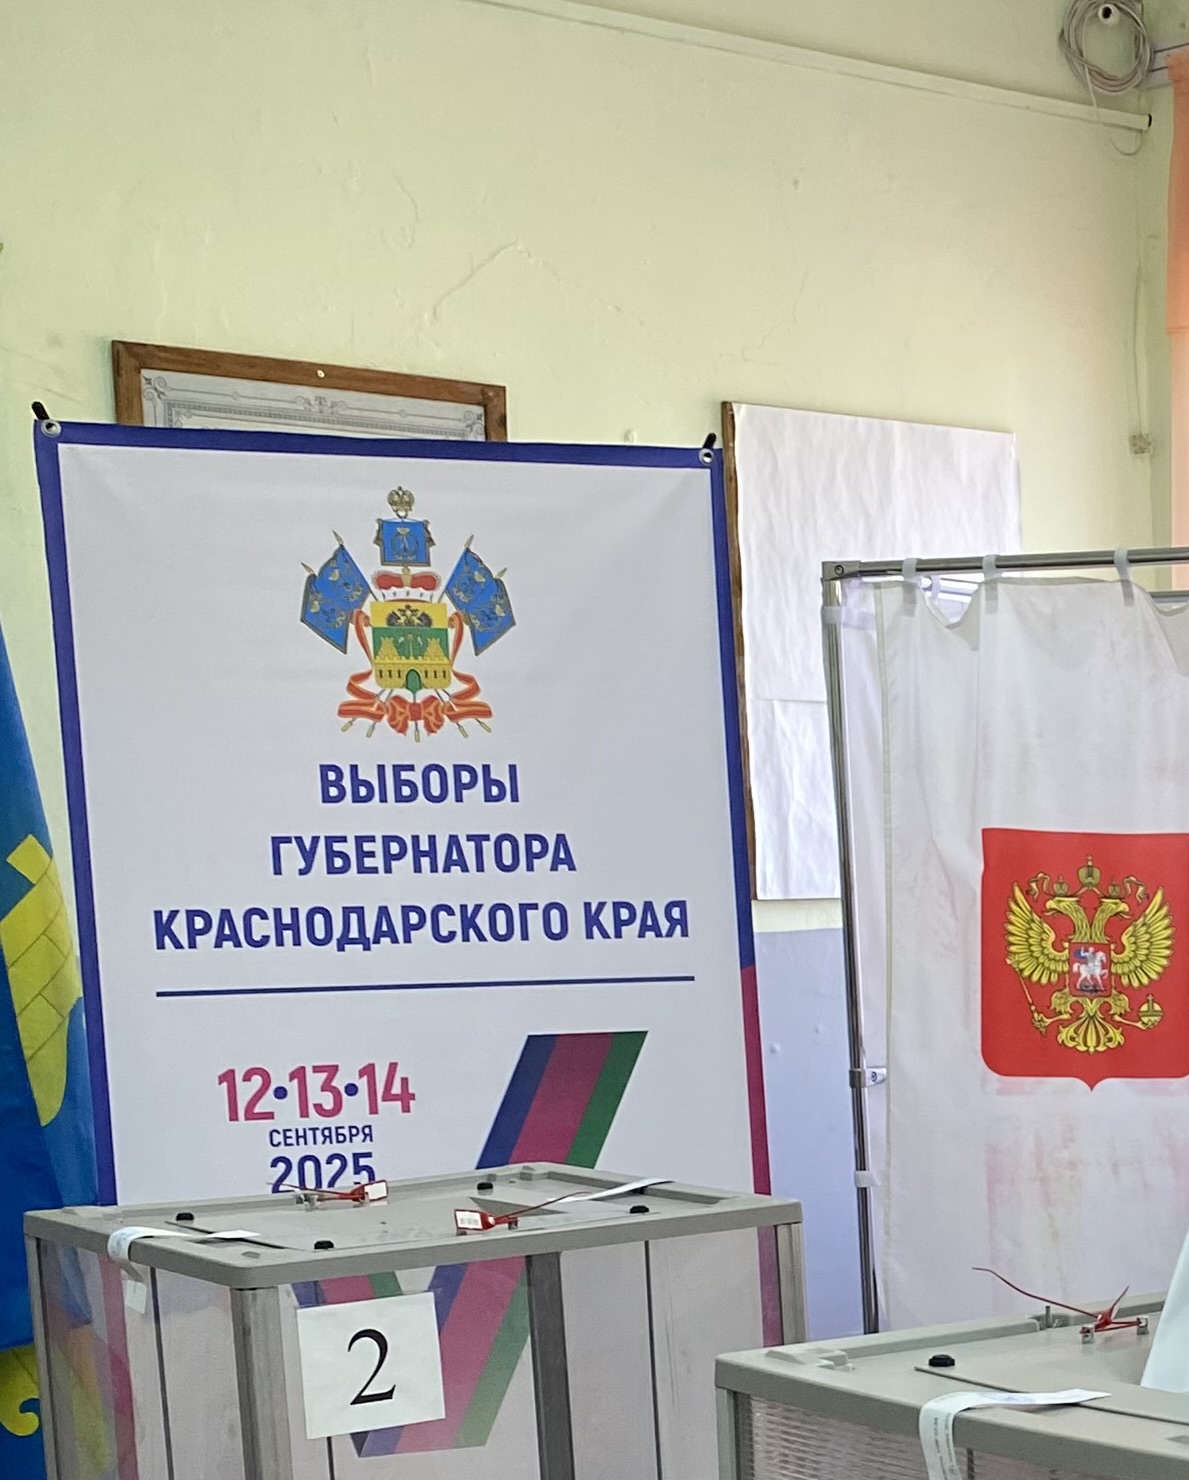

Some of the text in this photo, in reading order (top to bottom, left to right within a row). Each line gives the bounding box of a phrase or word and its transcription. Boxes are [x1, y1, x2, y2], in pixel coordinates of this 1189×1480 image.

[318, 762, 521, 805] ВЫБОРЫ
[269, 831, 578, 877] ГУБЕРНАТОРА
[152, 898, 690, 953] КРАСНОДАРСКОГО КРАЯ
[268, 1124, 374, 1148] СЕНТЯБРЯ
[269, 1151, 377, 1195] 2025
[346, 1327, 397, 1407] 2
